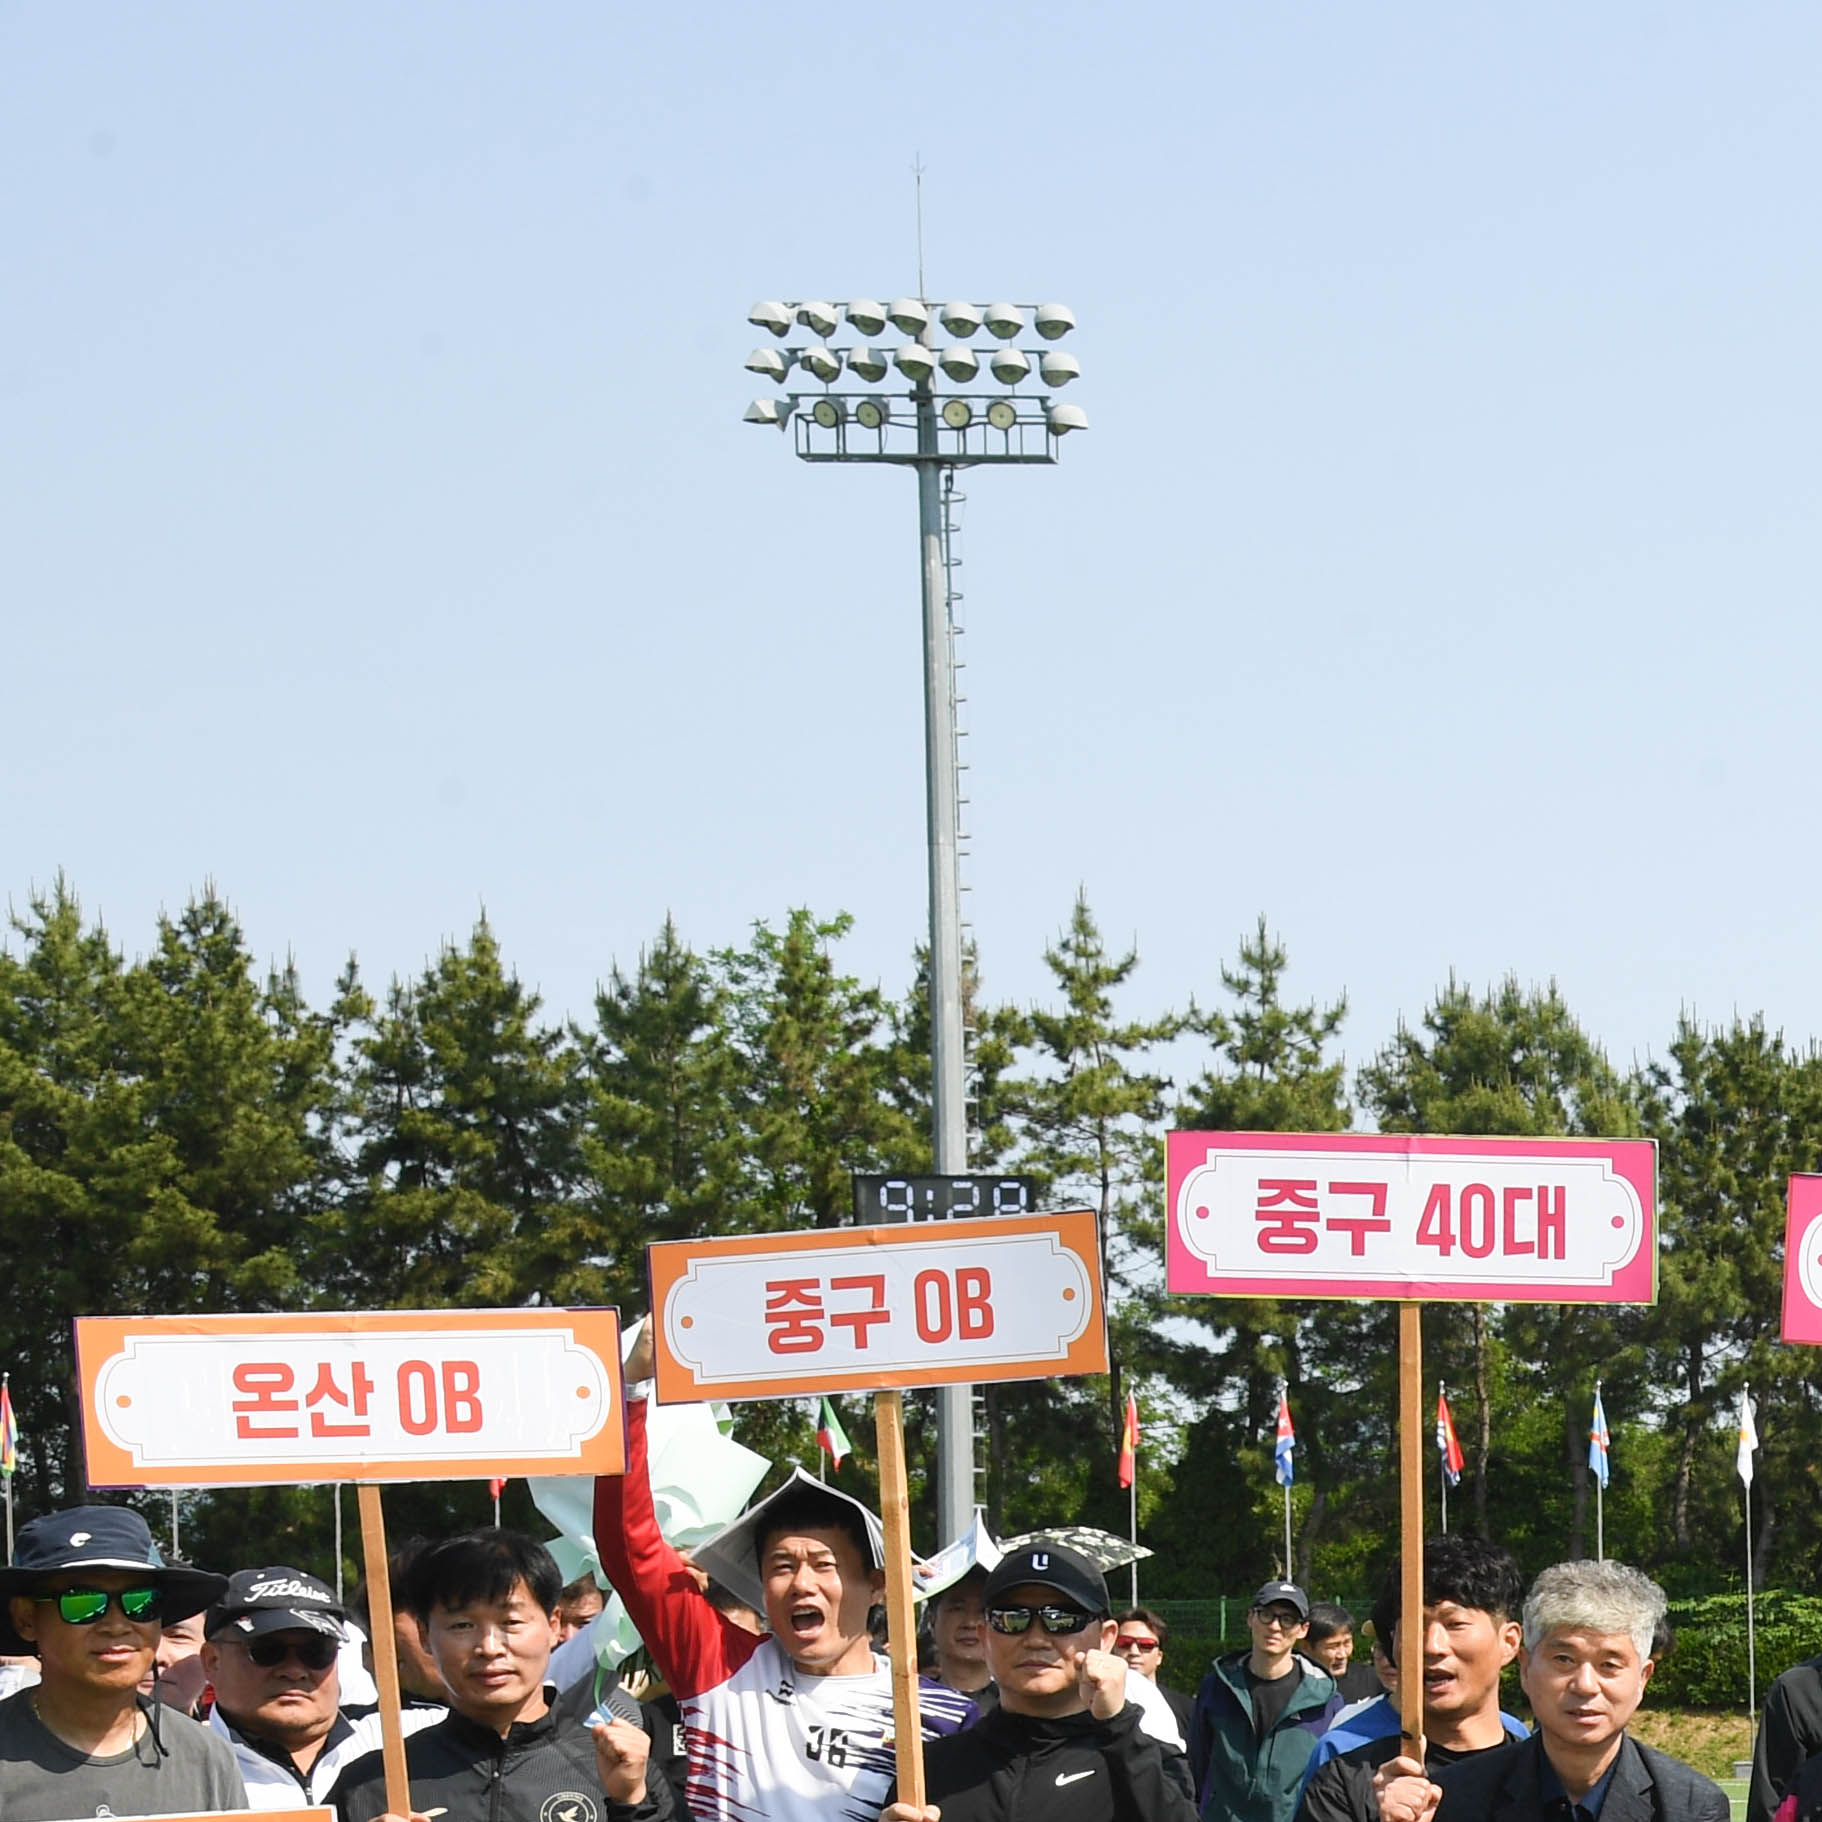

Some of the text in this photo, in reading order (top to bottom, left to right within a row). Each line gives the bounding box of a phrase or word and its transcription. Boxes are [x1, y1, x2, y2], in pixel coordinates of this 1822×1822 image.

[1257, 1180, 1565, 1258] 중구 40대
[767, 1269, 993, 1353] 중구 OB
[234, 1361, 482, 1438] 온산 OB
[243, 1578, 331, 1602] Titleist
